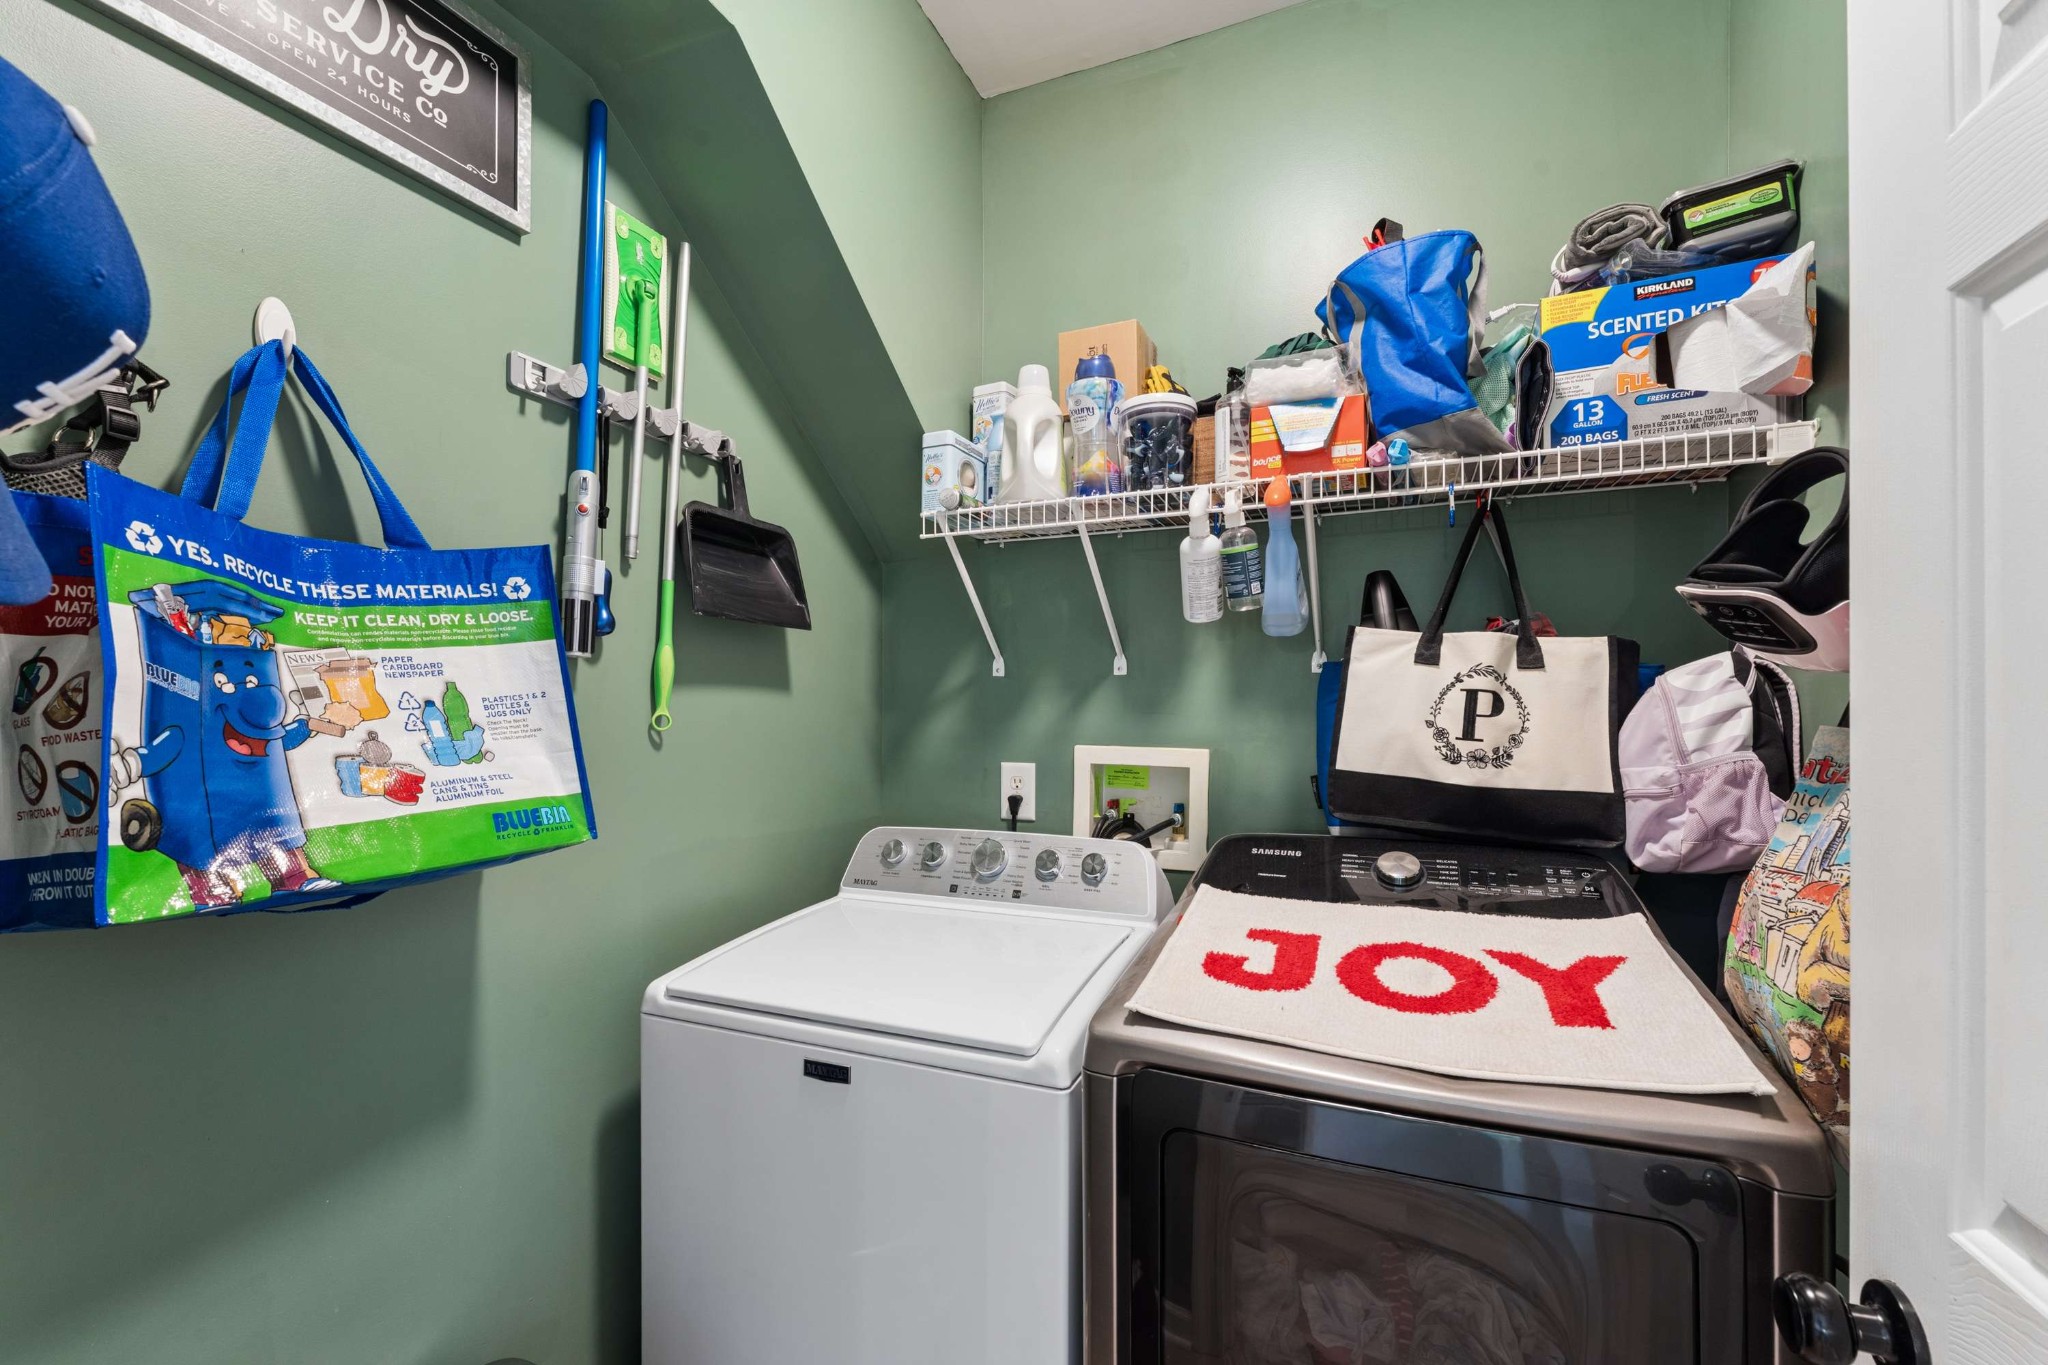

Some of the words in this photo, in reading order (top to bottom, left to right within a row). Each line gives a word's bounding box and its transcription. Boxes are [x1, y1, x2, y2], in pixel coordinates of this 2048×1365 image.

[323, 0, 469, 97] Dry
[256, 0, 405, 103] SERVICE
[415, 96, 448, 129] Co
[267, 32, 317, 69] OPEN
[327, 67, 348, 86] 24
[357, 85, 411, 124] HOURS
[1636, 278, 1694, 295] KIRKLAND
[1587, 307, 1684, 340] SCENTED
[1616, 372, 1668, 396] FLE
[1646, 393, 1670, 402] FRESH
[1671, 390, 1695, 399] SCENT
[1572, 400, 1604, 422] 13
[1573, 419, 1603, 428] GALLON
[1561, 435, 1582, 446] 200
[1585, 430, 1619, 443] BAGS
[1253, 455, 1282, 467] bounce
[167, 534, 219, 568] YES.
[223, 553, 296, 595] RECYCLE
[297, 581, 371, 600] THESE
[376, 582, 498, 600] MATERIALS!
[64, 584, 97, 599] NOT
[294, 611, 338, 627] KEEP
[343, 615, 360, 628] IT
[364, 614, 426, 628] CLEAN,
[428, 613, 460, 626] DRY
[464, 614, 476, 625] &
[479, 610, 534, 624] LOOSE.
[286, 653, 324, 665] NEWS
[381, 656, 413, 664] PAPER
[382, 662, 443, 671] CARDBOARD
[384, 670, 444, 678] NEWSPAPER
[482, 694, 524, 704] PLASTICS
[484, 702, 522, 711] BOTTLES
[510, 708, 532, 716] ONLY
[1455, 688, 1505, 742] P
[12, 717, 31, 730] GLASS
[64, 729, 102, 744] WASTE
[430, 776, 478, 788] ALUMINUM
[488, 773, 514, 782] STEEL
[432, 786, 458, 796] CANS
[469, 782, 489, 790] TINS
[436, 790, 484, 803] ALUMINUM
[486, 788, 504, 796] FOIL
[496, 830, 531, 840] RECYCLE
[542, 823, 574, 834] FRANKLIN
[1251, 848, 1302, 857] SAMSUNG
[53, 868, 63, 882] IN
[853, 878, 878, 886] MAYTAG
[64, 886, 73, 898] IT
[1202, 927, 1629, 1031] JOY
